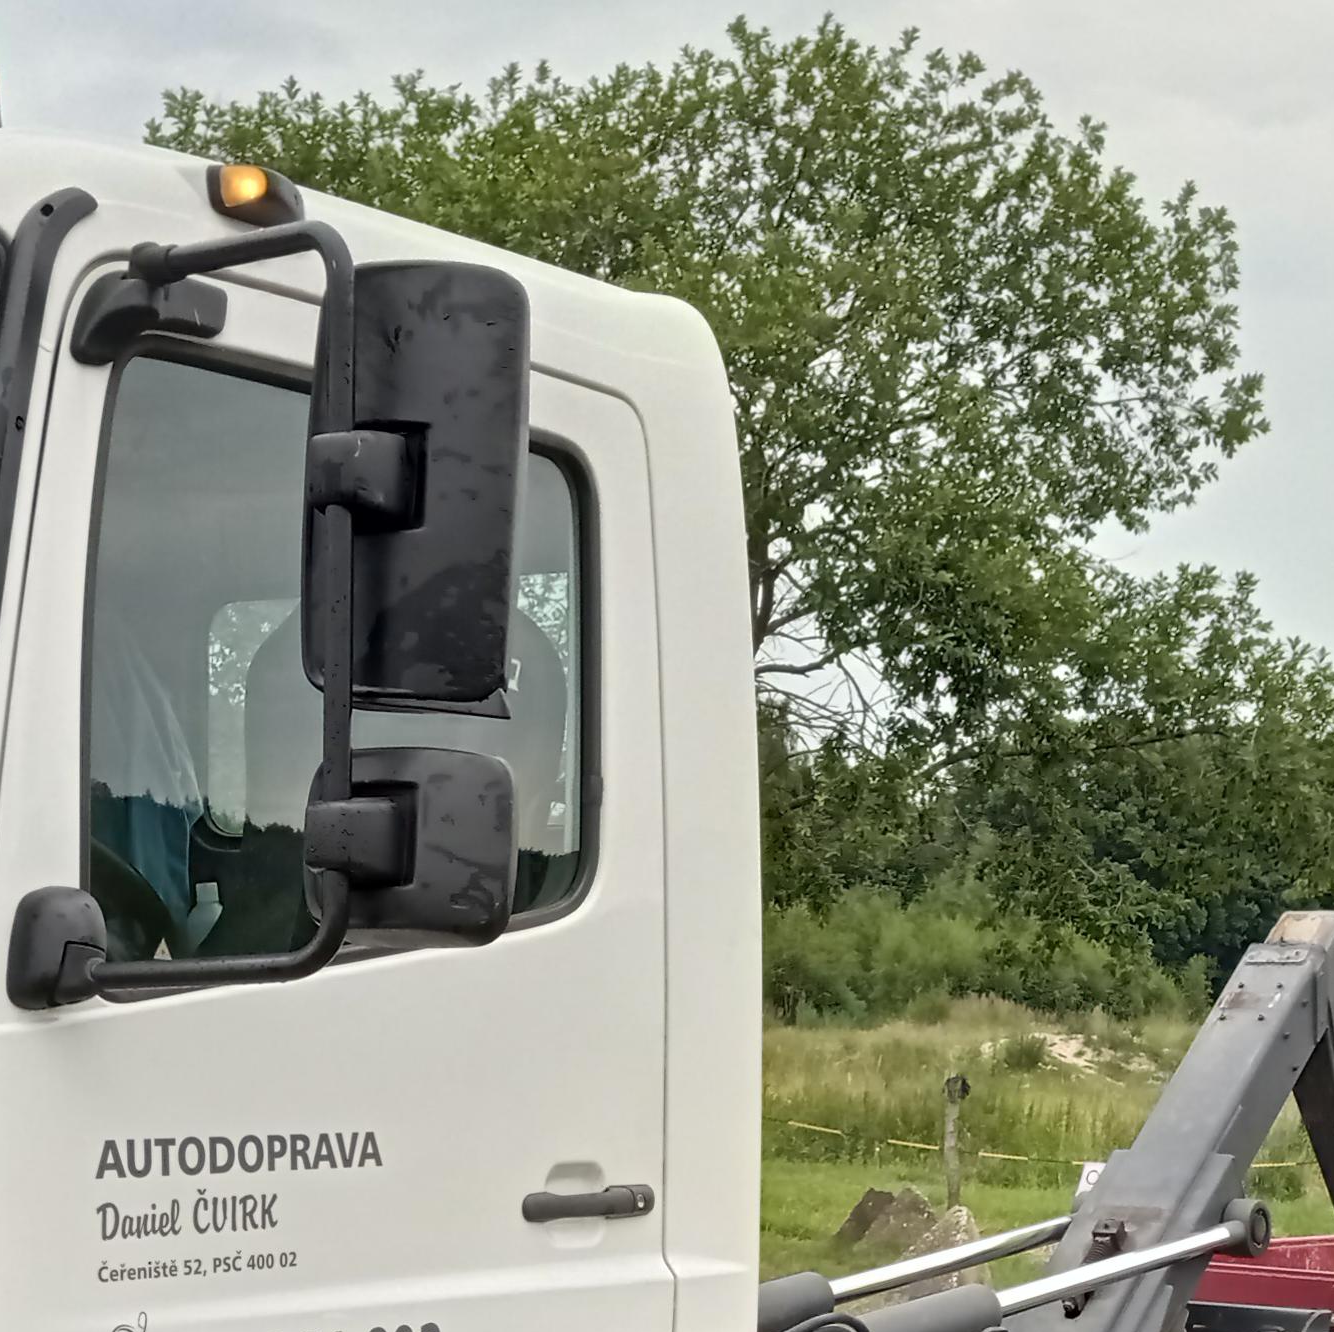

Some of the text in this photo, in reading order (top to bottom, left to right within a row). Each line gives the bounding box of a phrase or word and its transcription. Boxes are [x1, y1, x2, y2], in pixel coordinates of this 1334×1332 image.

[95, 1131, 383, 1180] AUTODOPRAVA
[96, 1198, 182, 1241] Daniel
[97, 1250, 298, 1283] Čeřeniště 52, PSČ 400 02
